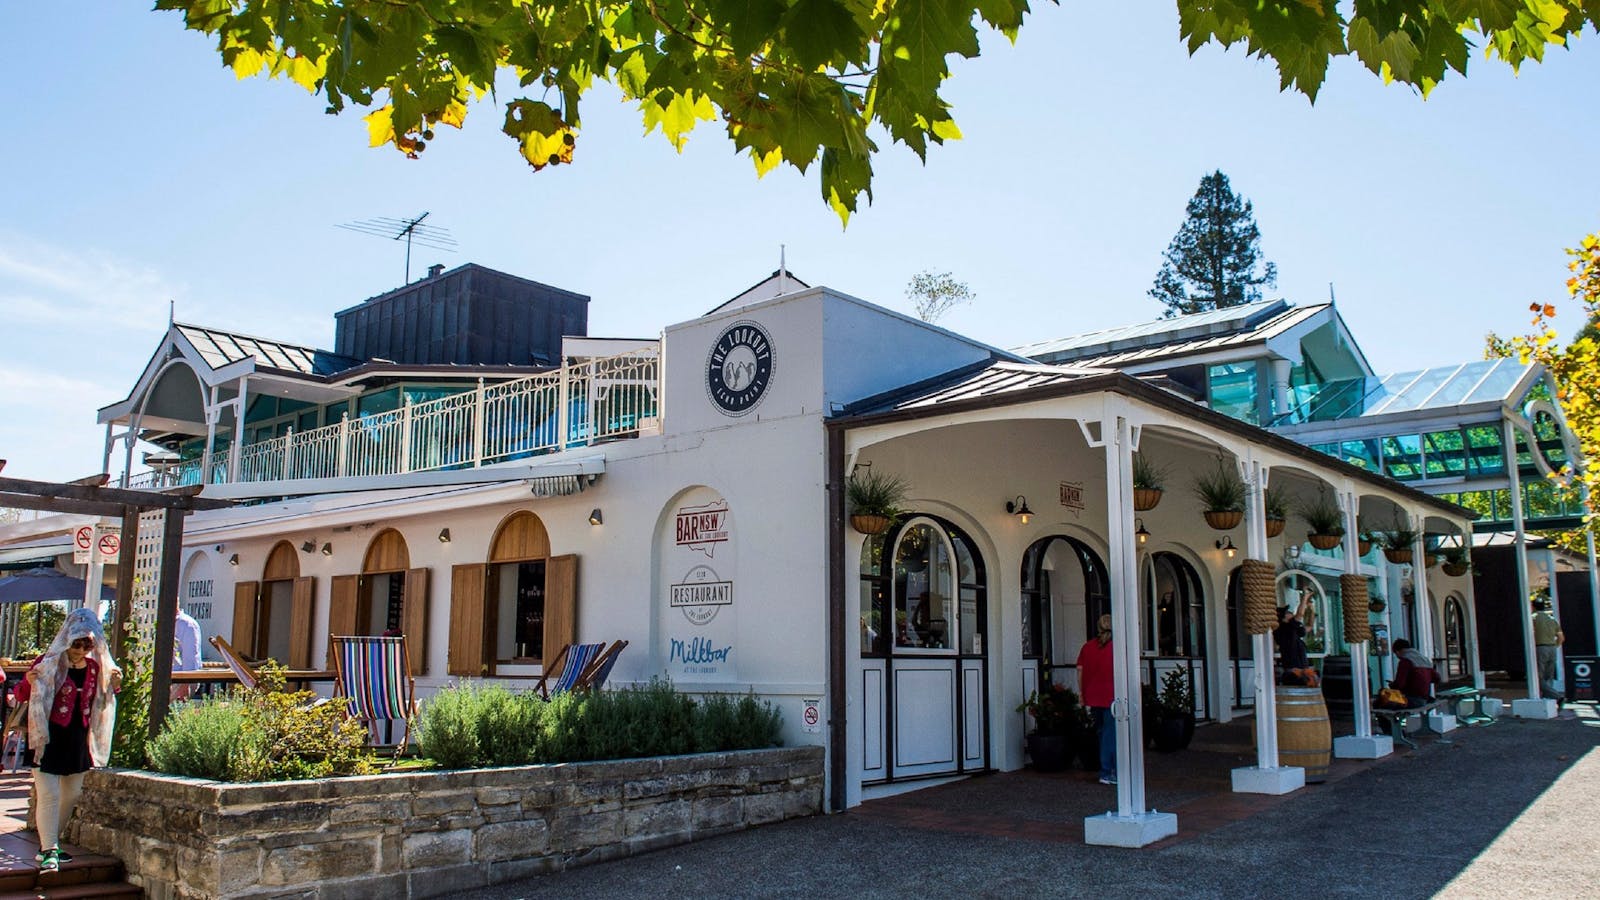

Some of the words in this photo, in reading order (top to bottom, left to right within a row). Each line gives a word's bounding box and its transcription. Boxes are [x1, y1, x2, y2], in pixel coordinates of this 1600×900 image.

[711, 344, 728, 370] THE
[728, 329, 770, 360] LOOKOUT
[674, 585, 729, 603] RESTAURANT
[670, 636, 732, 664] Milkbar
